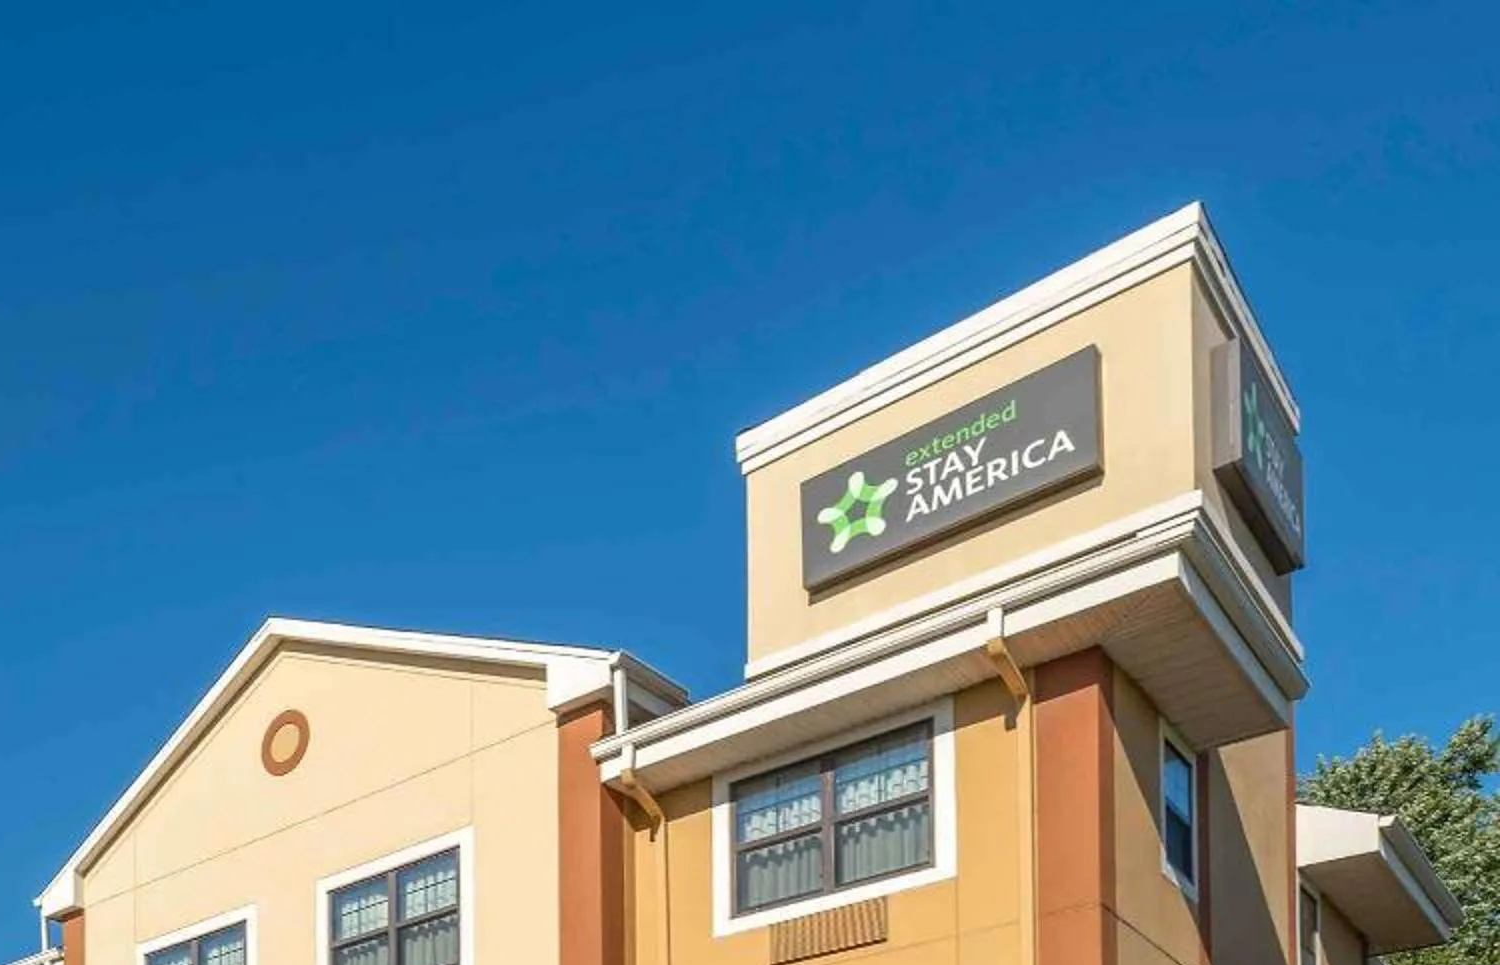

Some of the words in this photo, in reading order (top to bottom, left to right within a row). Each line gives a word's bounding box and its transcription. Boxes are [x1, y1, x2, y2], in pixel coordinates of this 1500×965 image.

[905, 400, 1018, 466] extended
[906, 436, 988, 495] STAY
[906, 429, 1076, 522] AMERICA
